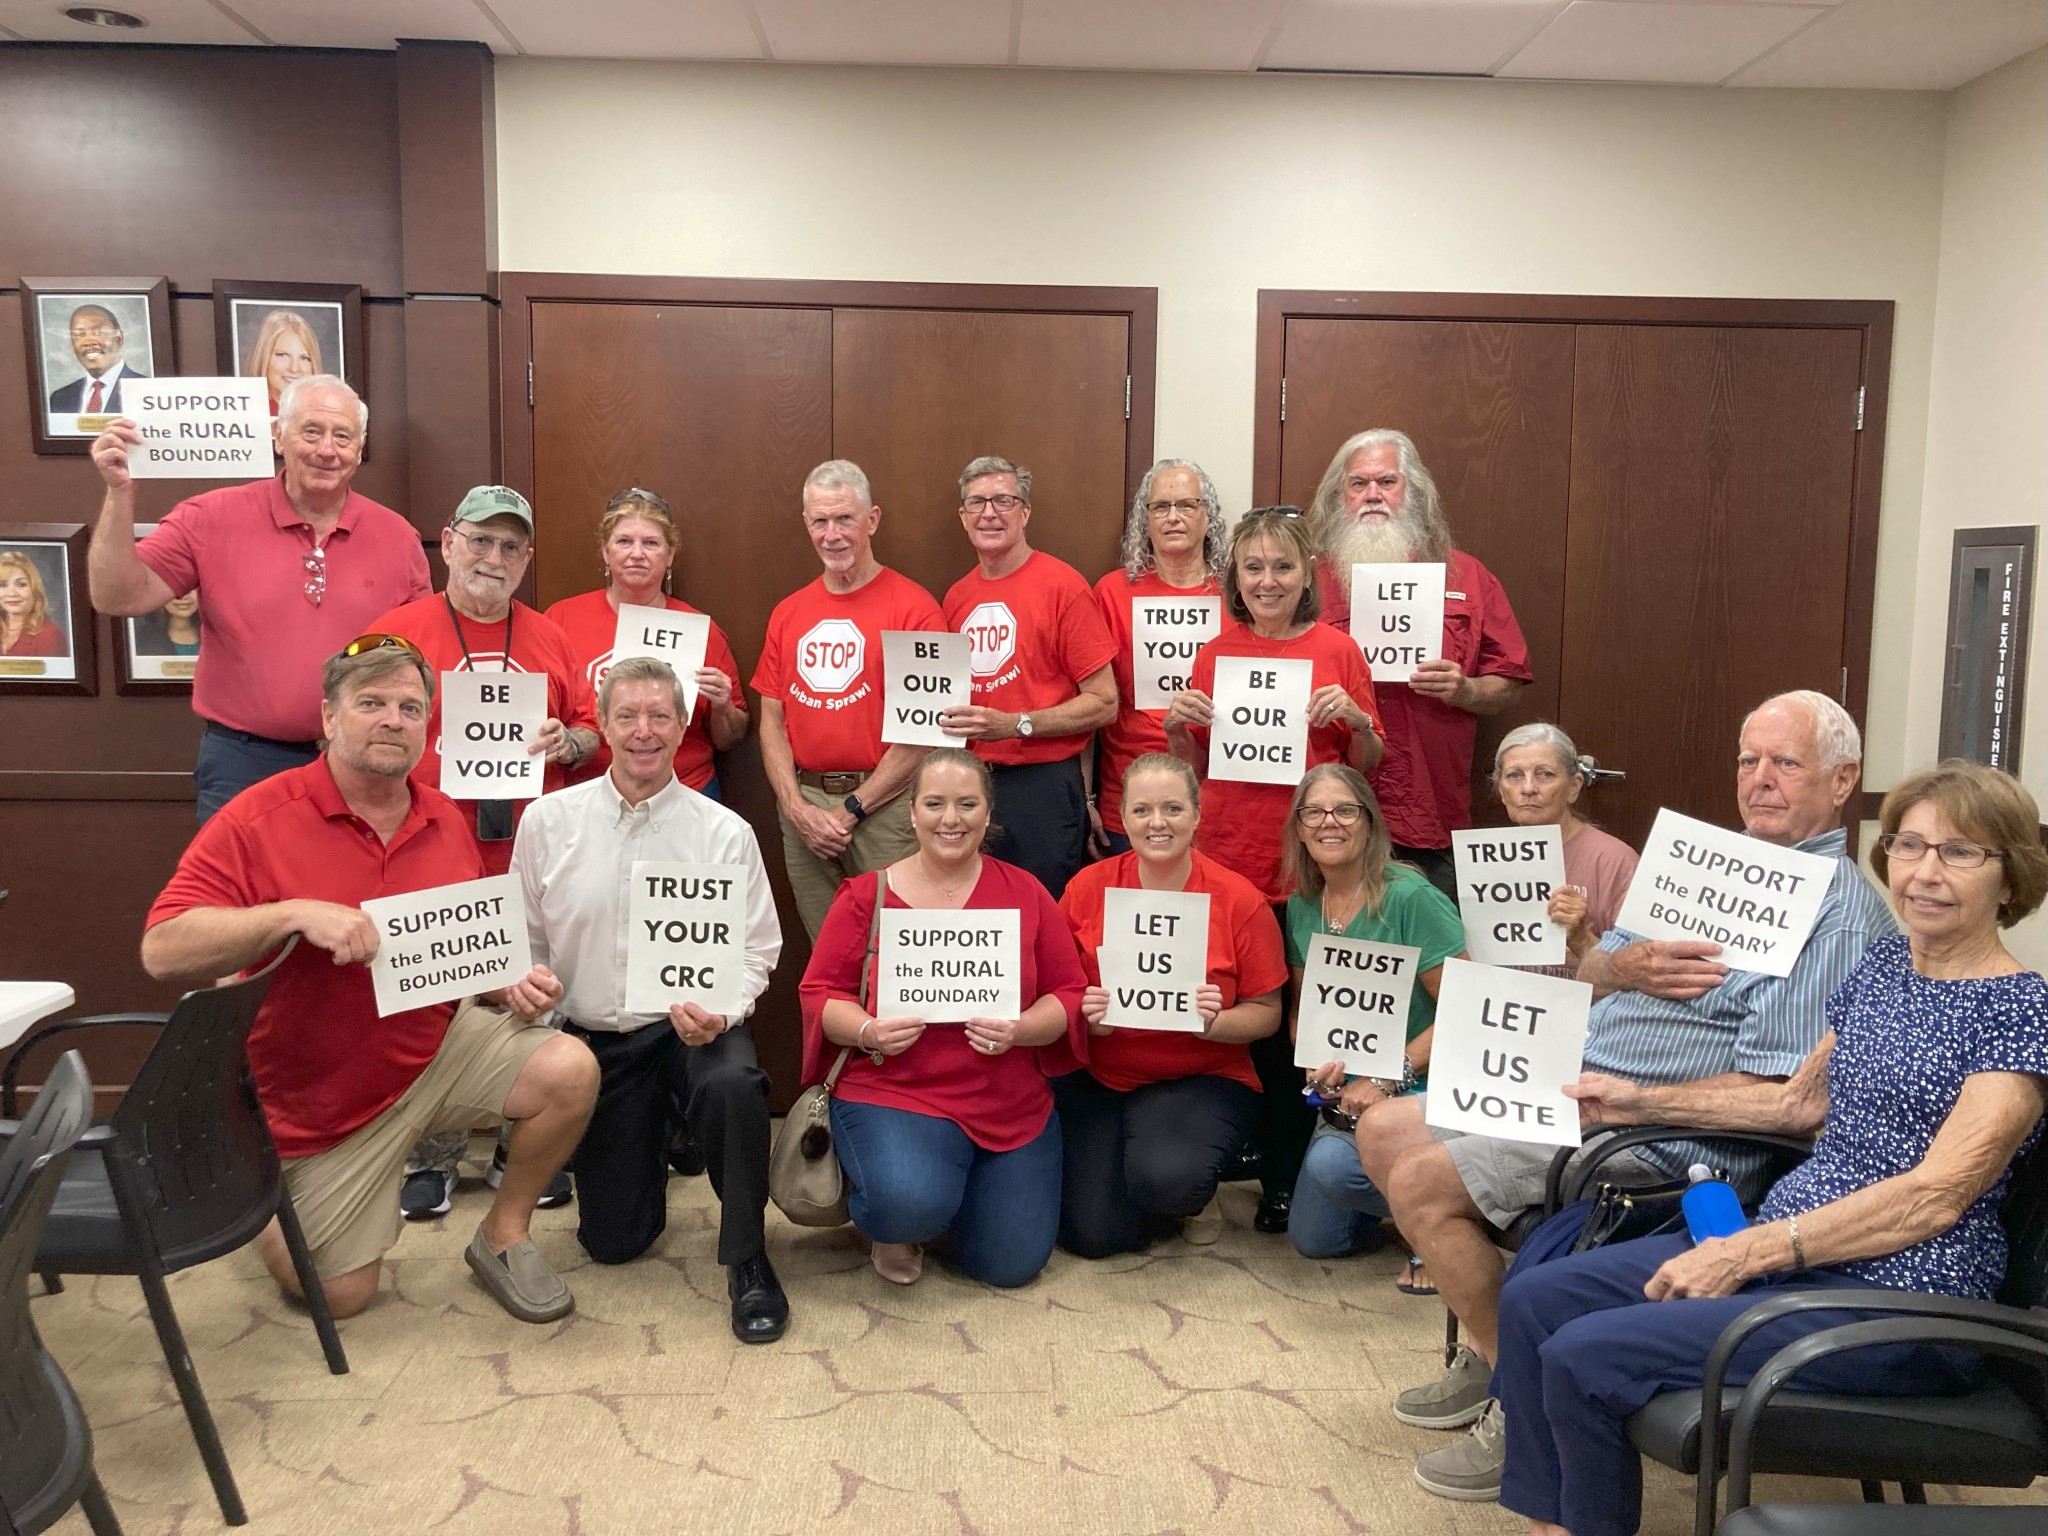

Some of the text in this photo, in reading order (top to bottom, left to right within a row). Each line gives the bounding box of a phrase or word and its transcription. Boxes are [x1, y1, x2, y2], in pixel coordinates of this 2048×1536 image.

[143, 395, 251, 412] SUPPORT
[142, 422, 255, 439] the RURAL
[150, 448, 252, 462] BOUNDARY
[1378, 582, 1418, 601] LET
[1144, 608, 1210, 625] TRUST
[1381, 614, 1411, 633] US
[643, 627, 683, 649] LET
[966, 624, 1009, 653] STOP
[804, 641, 856, 669] STOP
[914, 641, 940, 660] BE
[1363, 646, 1426, 665] VOTE
[1990, 563, 2013, 770] FIRE EXTINGUISHE
[903, 674, 952, 695] OUR
[1249, 670, 1277, 690] BE
[480, 684, 510, 704] BE
[789, 682, 871, 711] Urban Sprawl
[896, 707, 945, 728] VOIC
[1232, 706, 1287, 728] OUR
[464, 721, 525, 742] OUR
[1222, 742, 1293, 764] VOICE
[455, 759, 531, 778] VOICE
[1467, 840, 1548, 863] TRUST
[1669, 838, 1805, 896] SUPPORT
[645, 876, 733, 901] TRUST
[1470, 881, 1551, 903] YOUR
[1655, 874, 1790, 931] the RURAL
[388, 897, 504, 938] SUPPORT
[1134, 912, 1181, 937] LET
[1650, 902, 1776, 955] BOUNDARY
[643, 919, 730, 945] YOUR
[898, 929, 1003, 947] SUPPORT
[1493, 922, 1542, 943] CRC
[389, 928, 512, 969] the RURAL
[895, 960, 1005, 978] the RURAL
[1137, 951, 1172, 975] US
[1323, 946, 1405, 976] TRUST
[399, 956, 509, 993] BOUNDARY
[660, 964, 714, 989] CRC
[899, 988, 1000, 1003] BOUNDARY
[1117, 987, 1189, 1013] VOTE
[1316, 983, 1395, 1015] YOUR
[1481, 997, 1547, 1036] LET
[1327, 1027, 1378, 1054] CRC
[1482, 1049, 1529, 1083] US
[1452, 1088, 1557, 1127] VOTE
